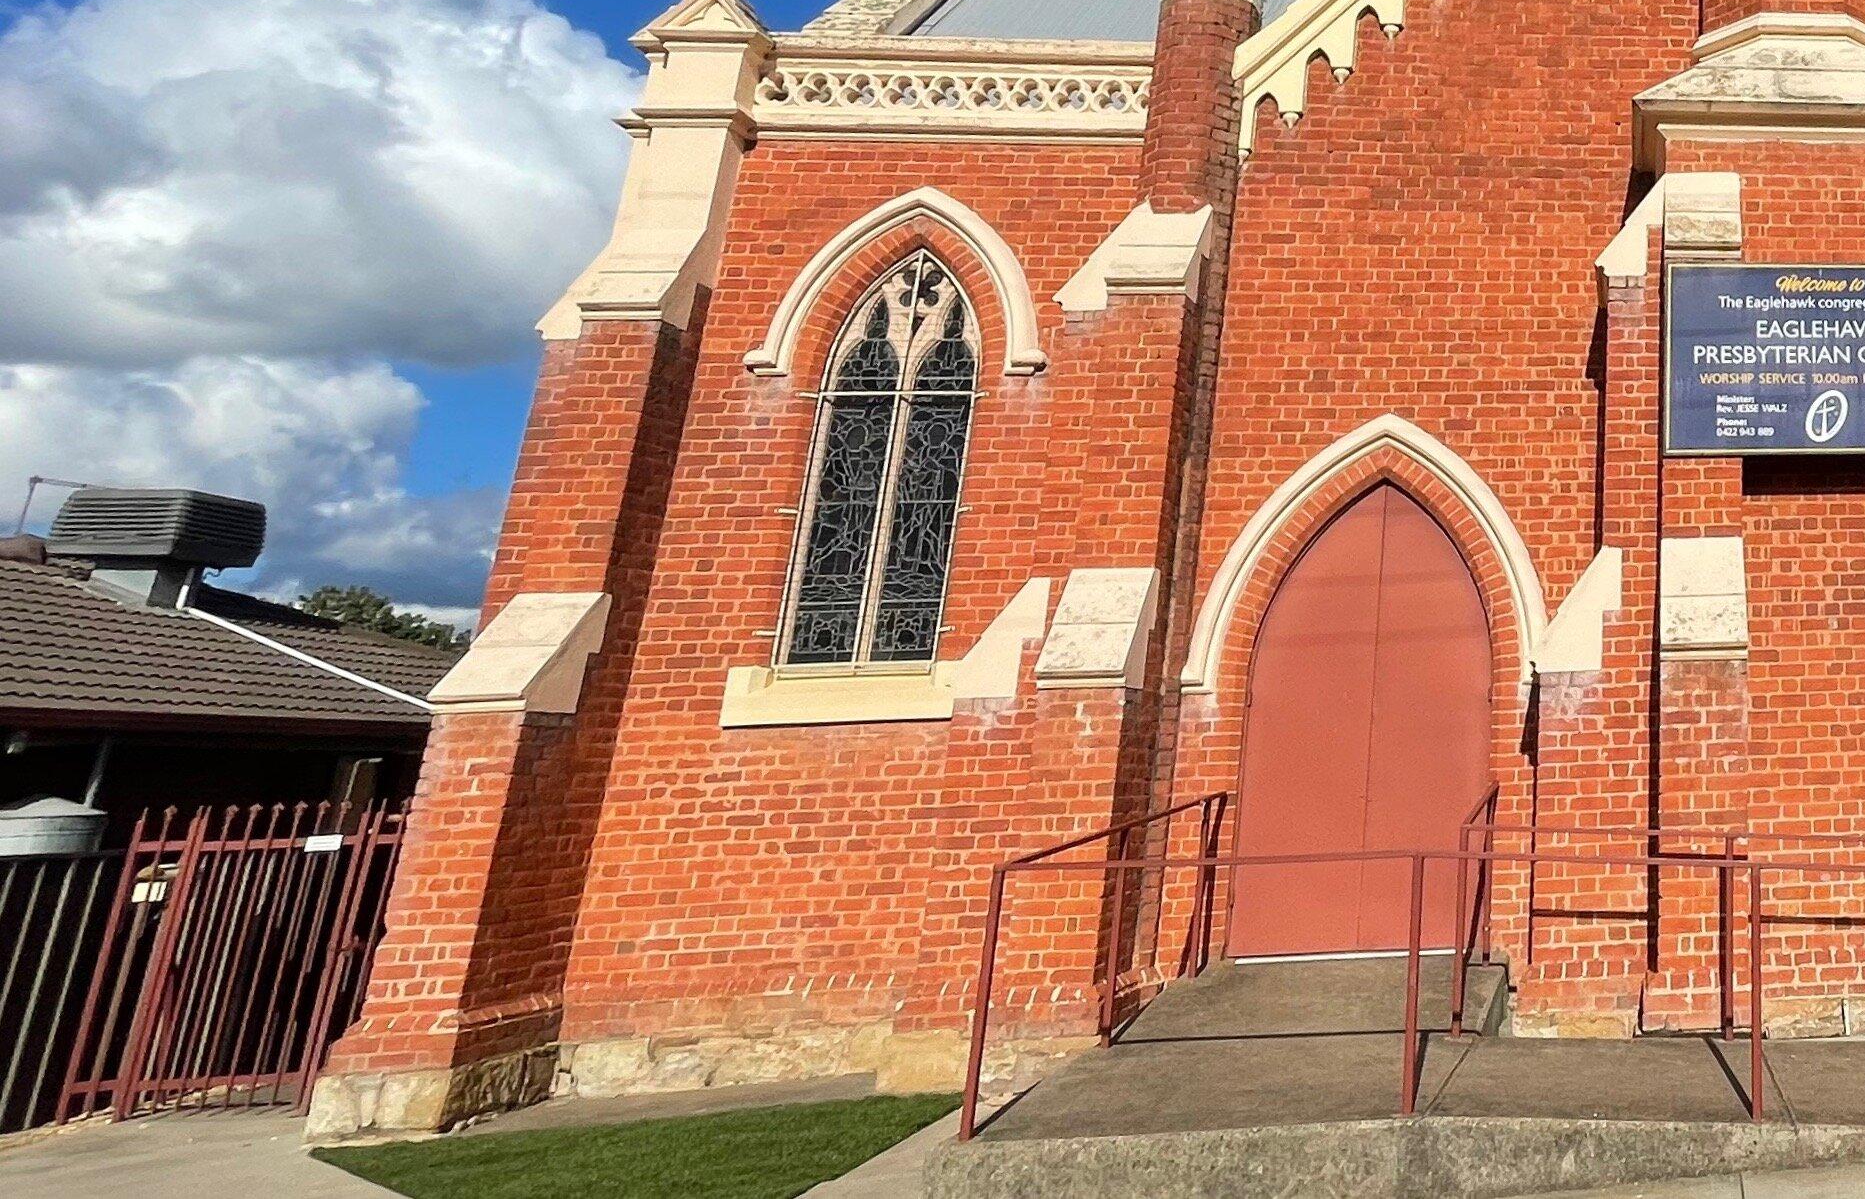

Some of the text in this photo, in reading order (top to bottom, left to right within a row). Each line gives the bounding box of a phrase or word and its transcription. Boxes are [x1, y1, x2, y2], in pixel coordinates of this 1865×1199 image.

[1775, 274, 1865, 292] Welcome to
[1718, 295, 1743, 308] The
[1746, 295, 1816, 311] Eaglehawk
[1693, 345, 1850, 364] PRESBYTERIAN
[1699, 373, 1754, 385] WORSHIP
[1758, 373, 1806, 385] SERVICE
[1736, 404, 1759, 413] JESSE
[1761, 403, 1787, 413] WALZ
